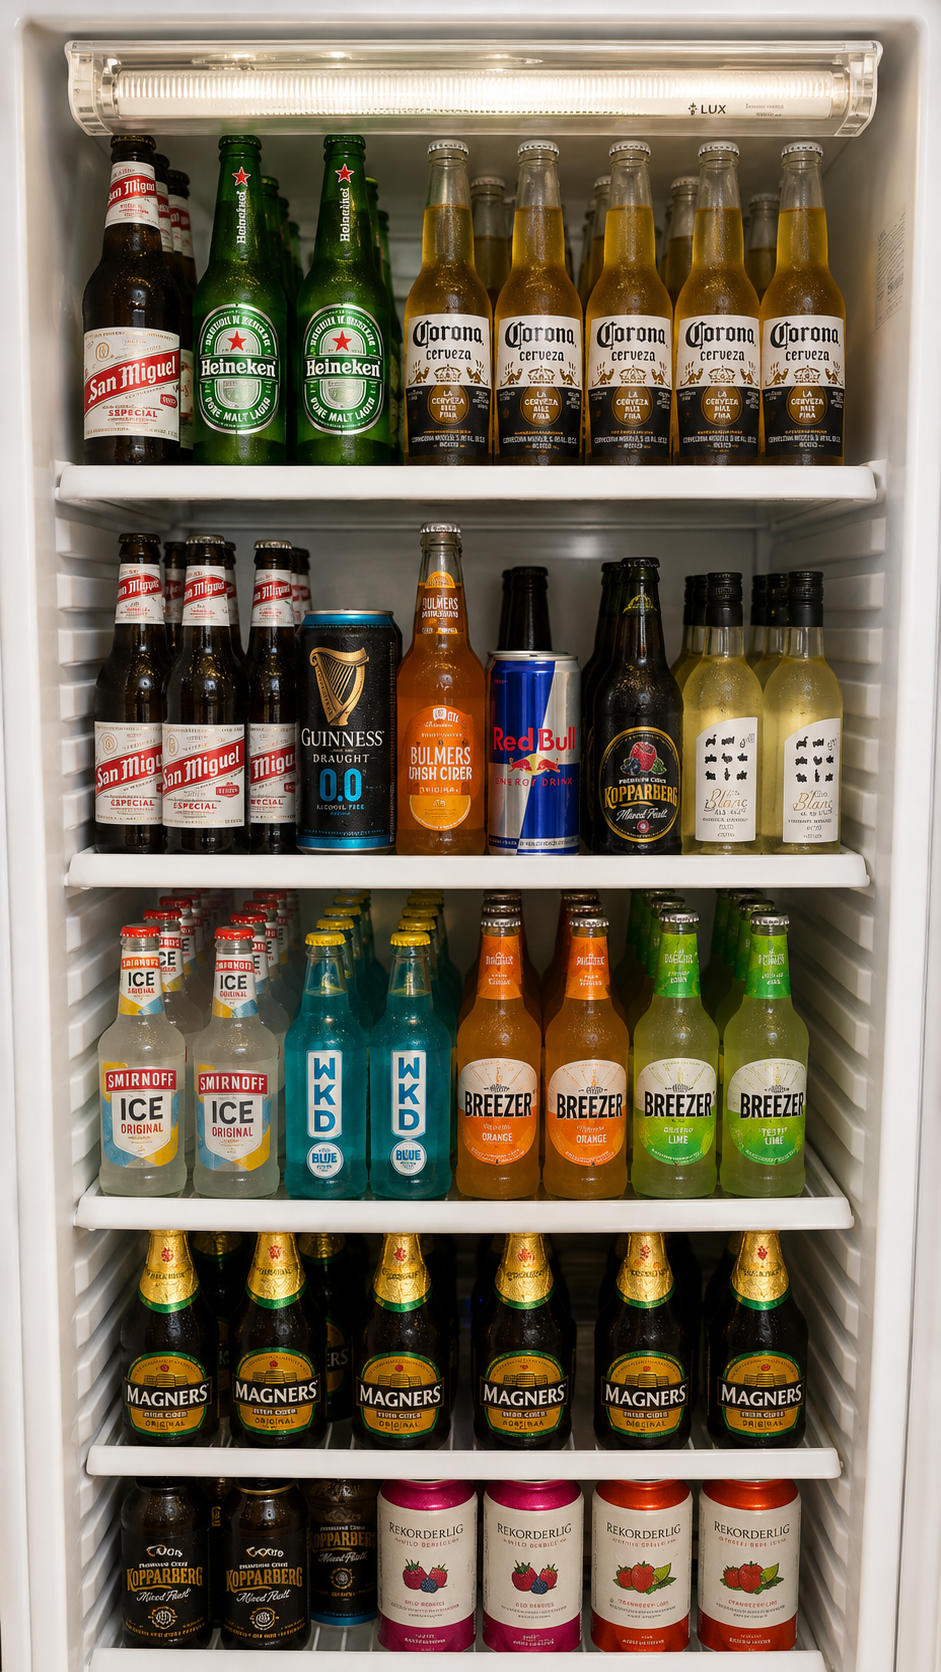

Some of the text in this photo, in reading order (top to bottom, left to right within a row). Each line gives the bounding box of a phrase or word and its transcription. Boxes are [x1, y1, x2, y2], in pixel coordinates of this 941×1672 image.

[701, 104, 727, 114] LUX
[412, 320, 484, 349] Corona
[504, 321, 575, 350] Corona
[596, 322, 666, 350] Corona
[686, 320, 755, 350] Corona
[770, 320, 840, 350] Corona
[426, 350, 472, 360] cerveza
[520, 350, 564, 362] cerveza
[611, 351, 656, 362] cerveza
[700, 350, 745, 361] cerveza
[786, 350, 830, 362] cerveza
[201, 358, 276, 378] Heineken
[306, 358, 381, 378] Heineken
[88, 355, 176, 404] San Miguel
[301, 728, 384, 747] GUINNESS
[493, 726, 534, 751] Red
[538, 726, 576, 752] Bull
[184, 745, 240, 782] Miguel
[313, 754, 370, 764] DRAUGHT
[410, 746, 471, 765] BULMERS
[97, 767, 118, 788] San
[320, 768, 362, 802] 0.0
[496, 777, 573, 787] ENERGY DRINK
[604, 784, 678, 809] KOPPARBERG
[128, 972, 155, 987] ICE
[220, 974, 248, 990] ICE
[108, 1072, 174, 1088] SMIRNOFF
[200, 1076, 265, 1091] SMIRNOFF
[314, 1058, 336, 1132] WKD
[398, 1057, 420, 1131] WKD
[644, 1091, 712, 1117] BREEZER
[120, 1096, 164, 1121] ICE
[212, 1100, 254, 1124] ICE
[464, 1091, 532, 1118] BREEZER
[556, 1094, 623, 1120] BREEZER
[740, 1092, 804, 1119] BREEZER
[121, 1123, 164, 1135] ORIGINAL
[212, 1126, 254, 1138] ORIGINAL
[482, 1132, 513, 1142] ORANGE
[576, 1134, 608, 1144] ORANGE
[668, 1135, 689, 1144] LIME
[312, 1152, 338, 1164] BLUE
[396, 1150, 422, 1161] BLUE
[126, 1384, 208, 1407] MAGNERS
[236, 1381, 317, 1404] MAGNERS
[360, 1384, 442, 1407] MAGNERS
[484, 1384, 566, 1407] MAGNERS
[605, 1384, 686, 1407] MAGNERS
[722, 1384, 802, 1407] MAGNERS
[389, 1521, 464, 1540] REKORDERLIG
[497, 1522, 572, 1540] REKORDERLIG
[606, 1521, 682, 1540] REKORDERLIG
[714, 1520, 790, 1540] REKORDERLIG
[126, 1567, 203, 1592] KOPPARBERG
[226, 1567, 303, 1592] KOPPARBERG
